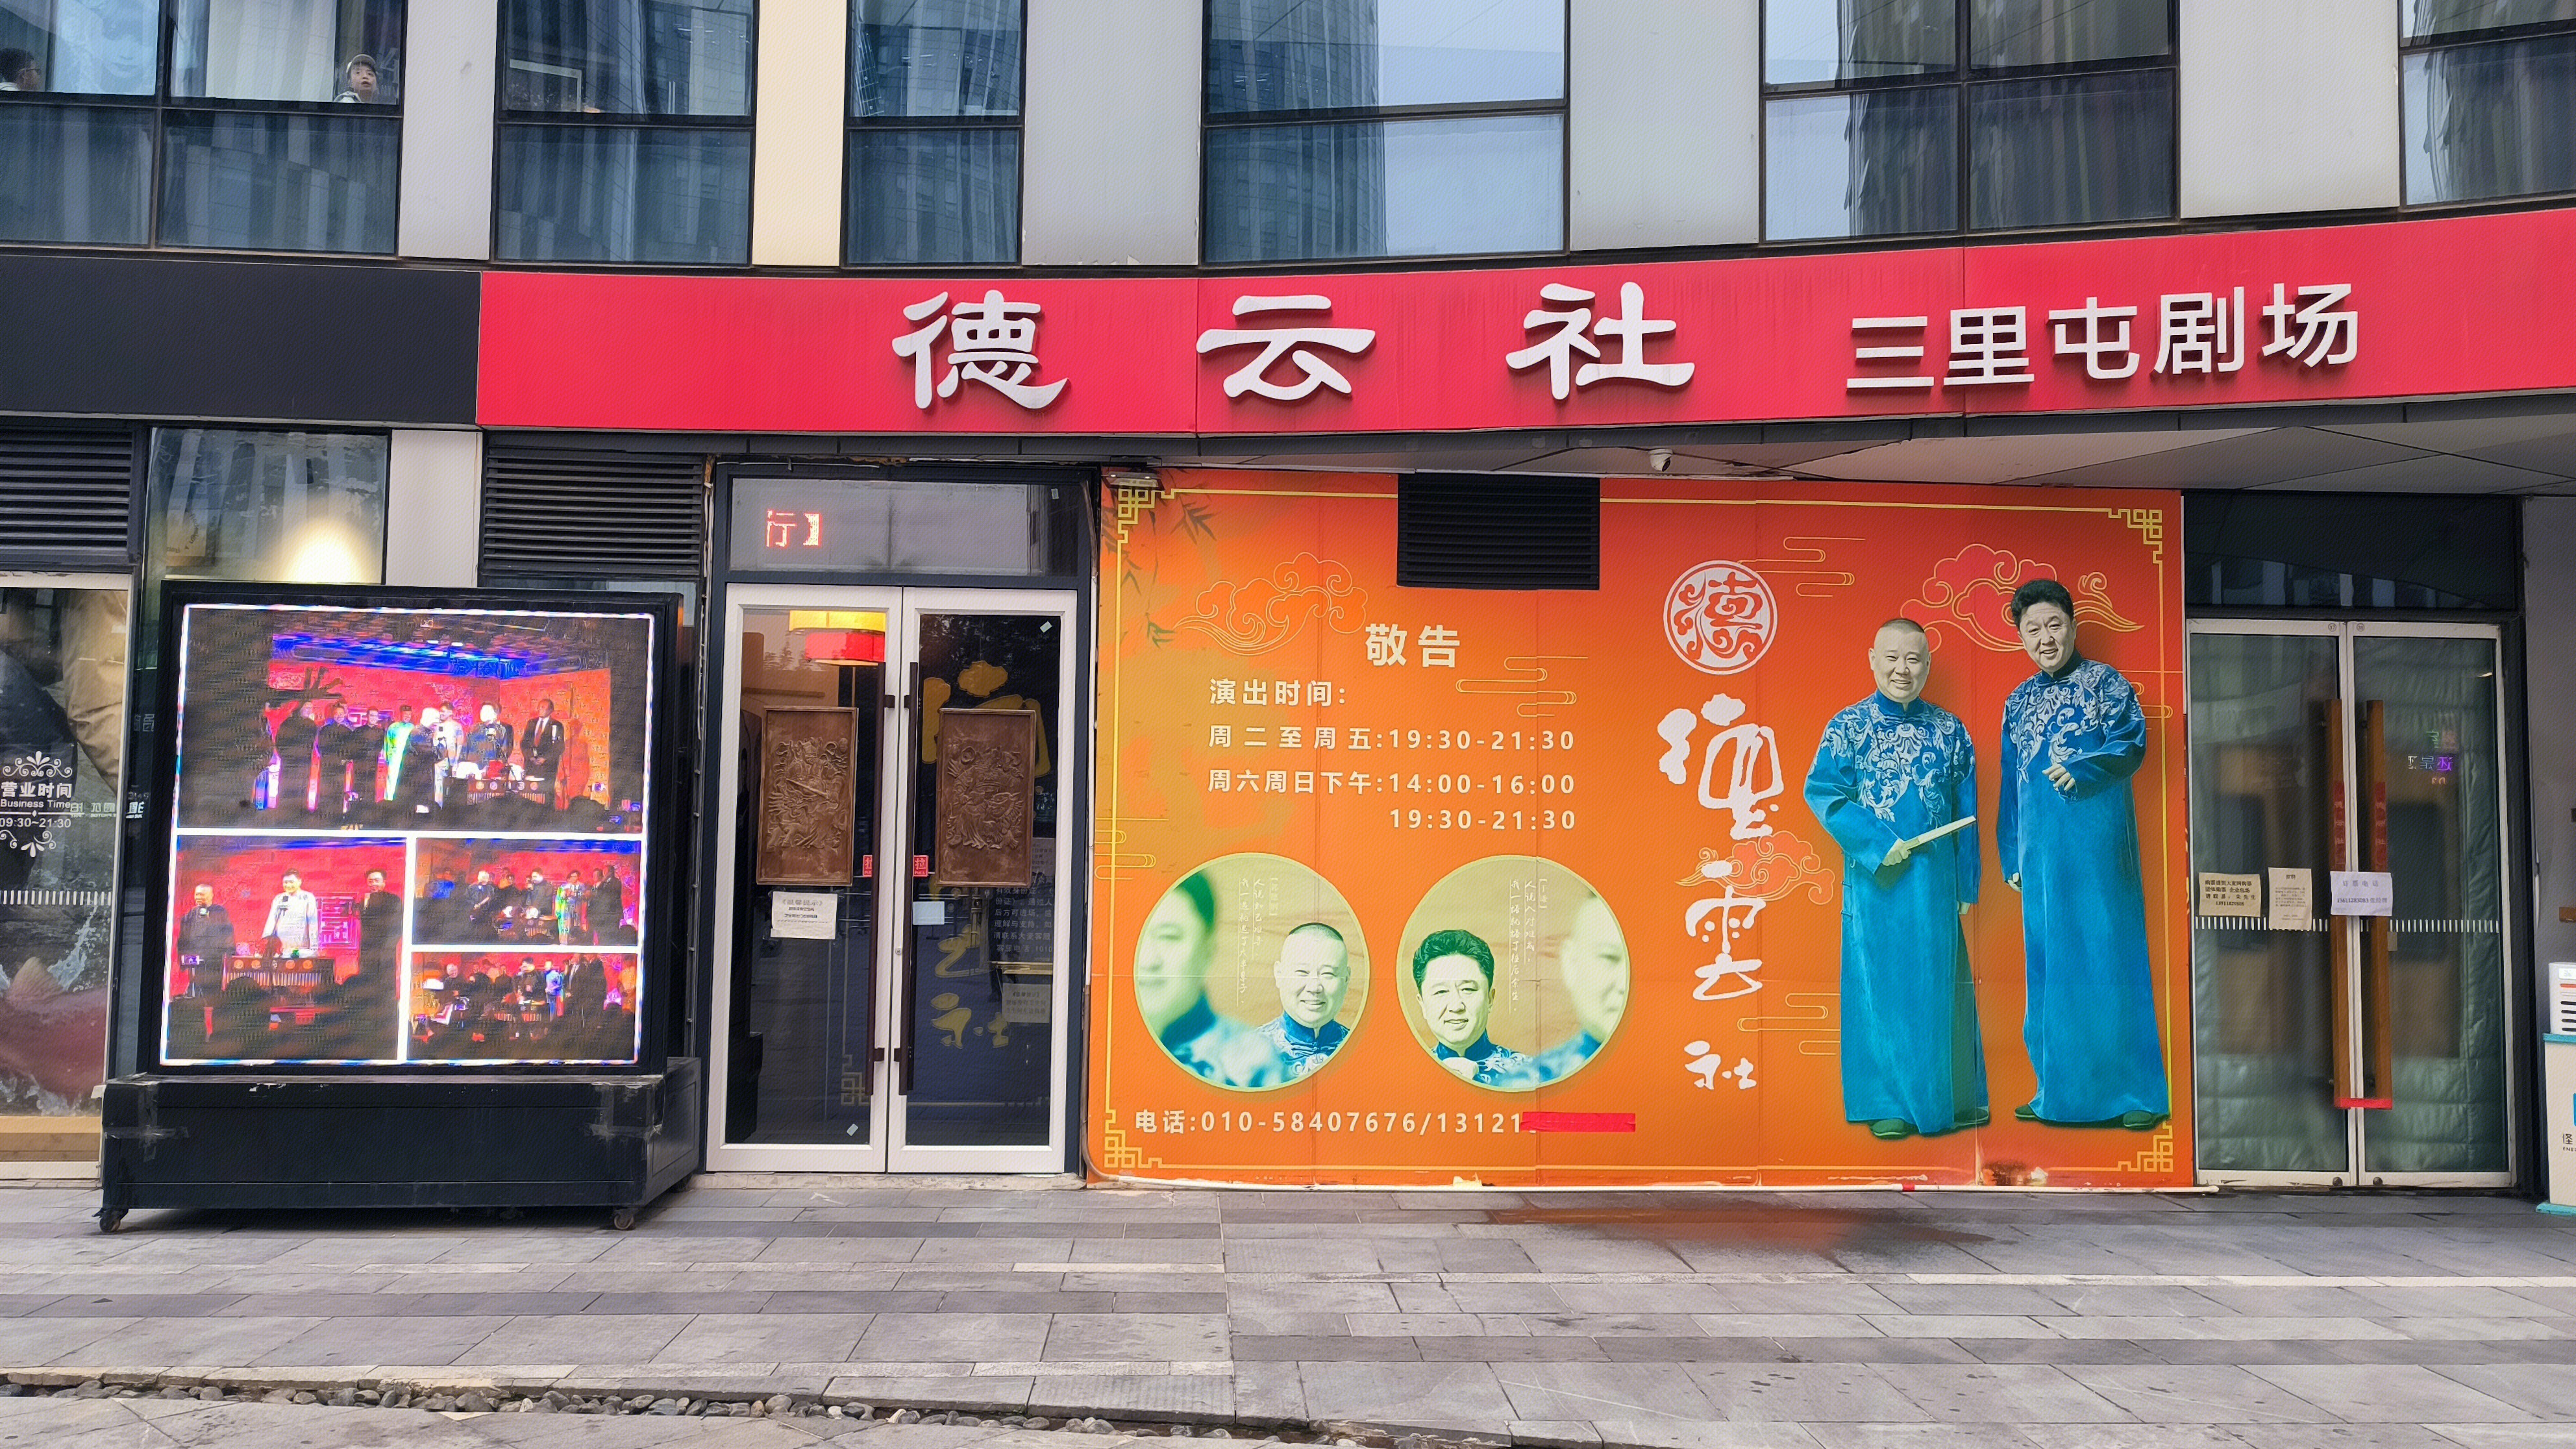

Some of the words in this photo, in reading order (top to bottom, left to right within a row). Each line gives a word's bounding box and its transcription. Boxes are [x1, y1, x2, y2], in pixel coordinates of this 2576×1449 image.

[892, 282, 1694, 411] 德云社
[1847, 283, 2359, 390] 三里屯剧场
[1365, 623, 1461, 668] 敬告
[1209, 678, 1346, 708] 演出时间:
[1, 782, 73, 799] 营业时间
[1207, 769, 1575, 795] 周六周日下午:14:00-16:00
[0, 799, 44, 808] Business
[47, 799, 71, 808] Time
[0, 818, 71, 828] 09:30~21:30
[1389, 809, 1576, 830] 19:30-21:30
[915, 858, 926, 870] 拉
